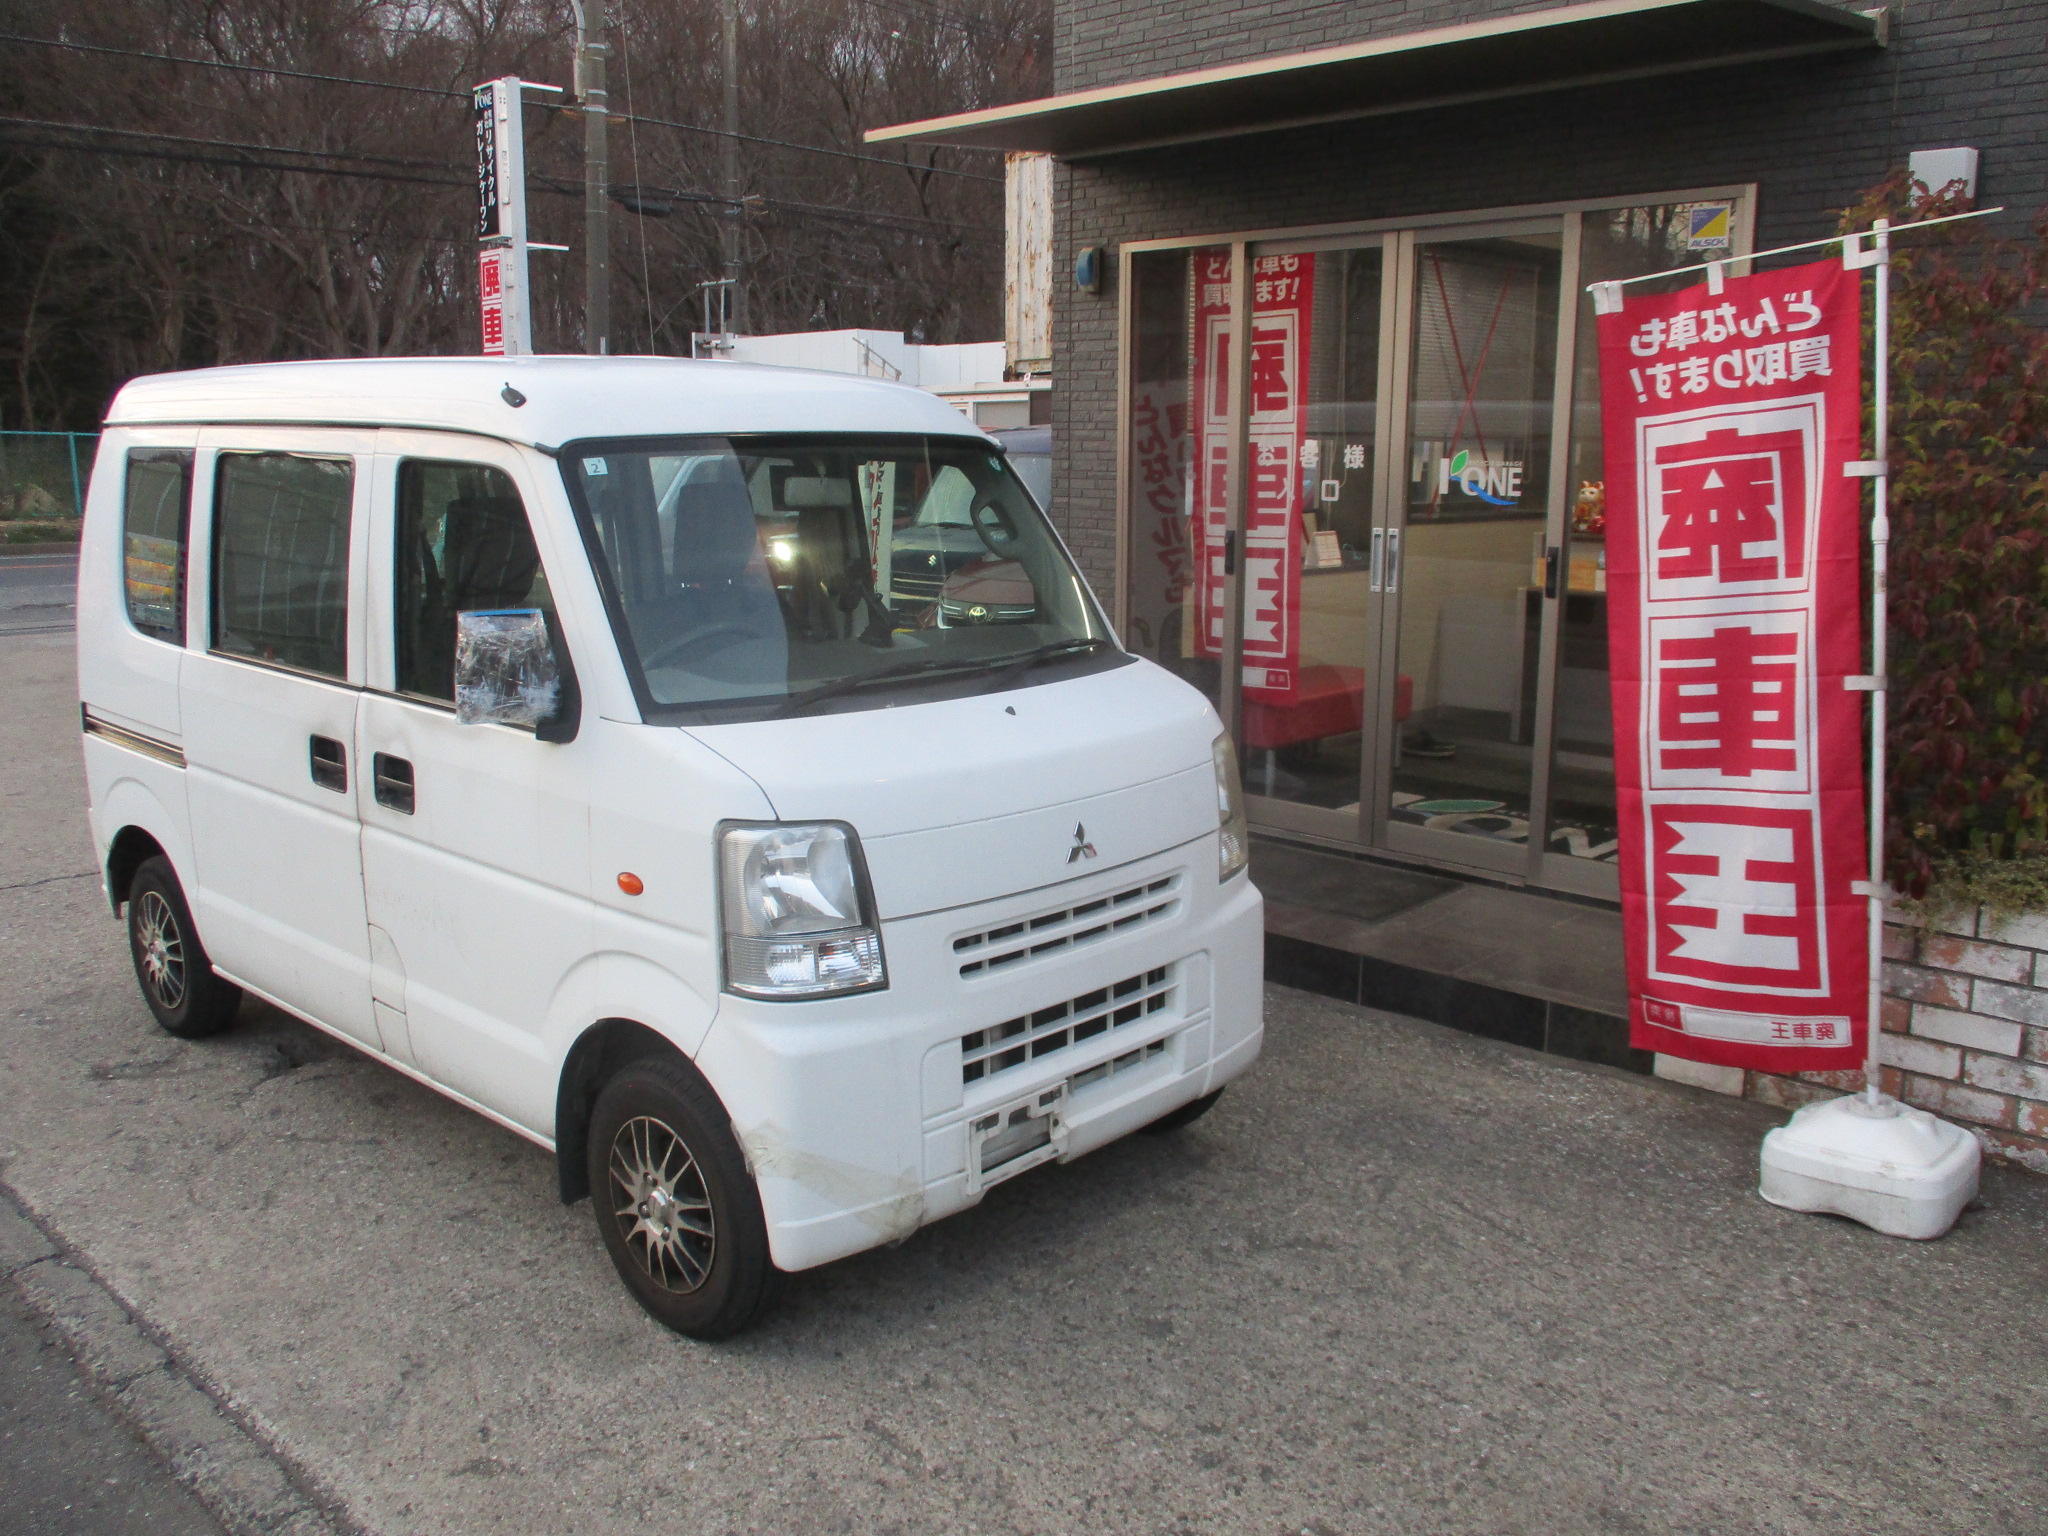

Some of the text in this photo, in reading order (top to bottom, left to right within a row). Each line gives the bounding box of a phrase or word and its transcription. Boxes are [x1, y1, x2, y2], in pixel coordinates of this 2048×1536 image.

[476, 120, 488, 233] ガレージケーワン
[486, 129, 496, 207] リサイクル
[1690, 238, 1727, 248] ALSOK
[590, 463, 601, 474] 2
